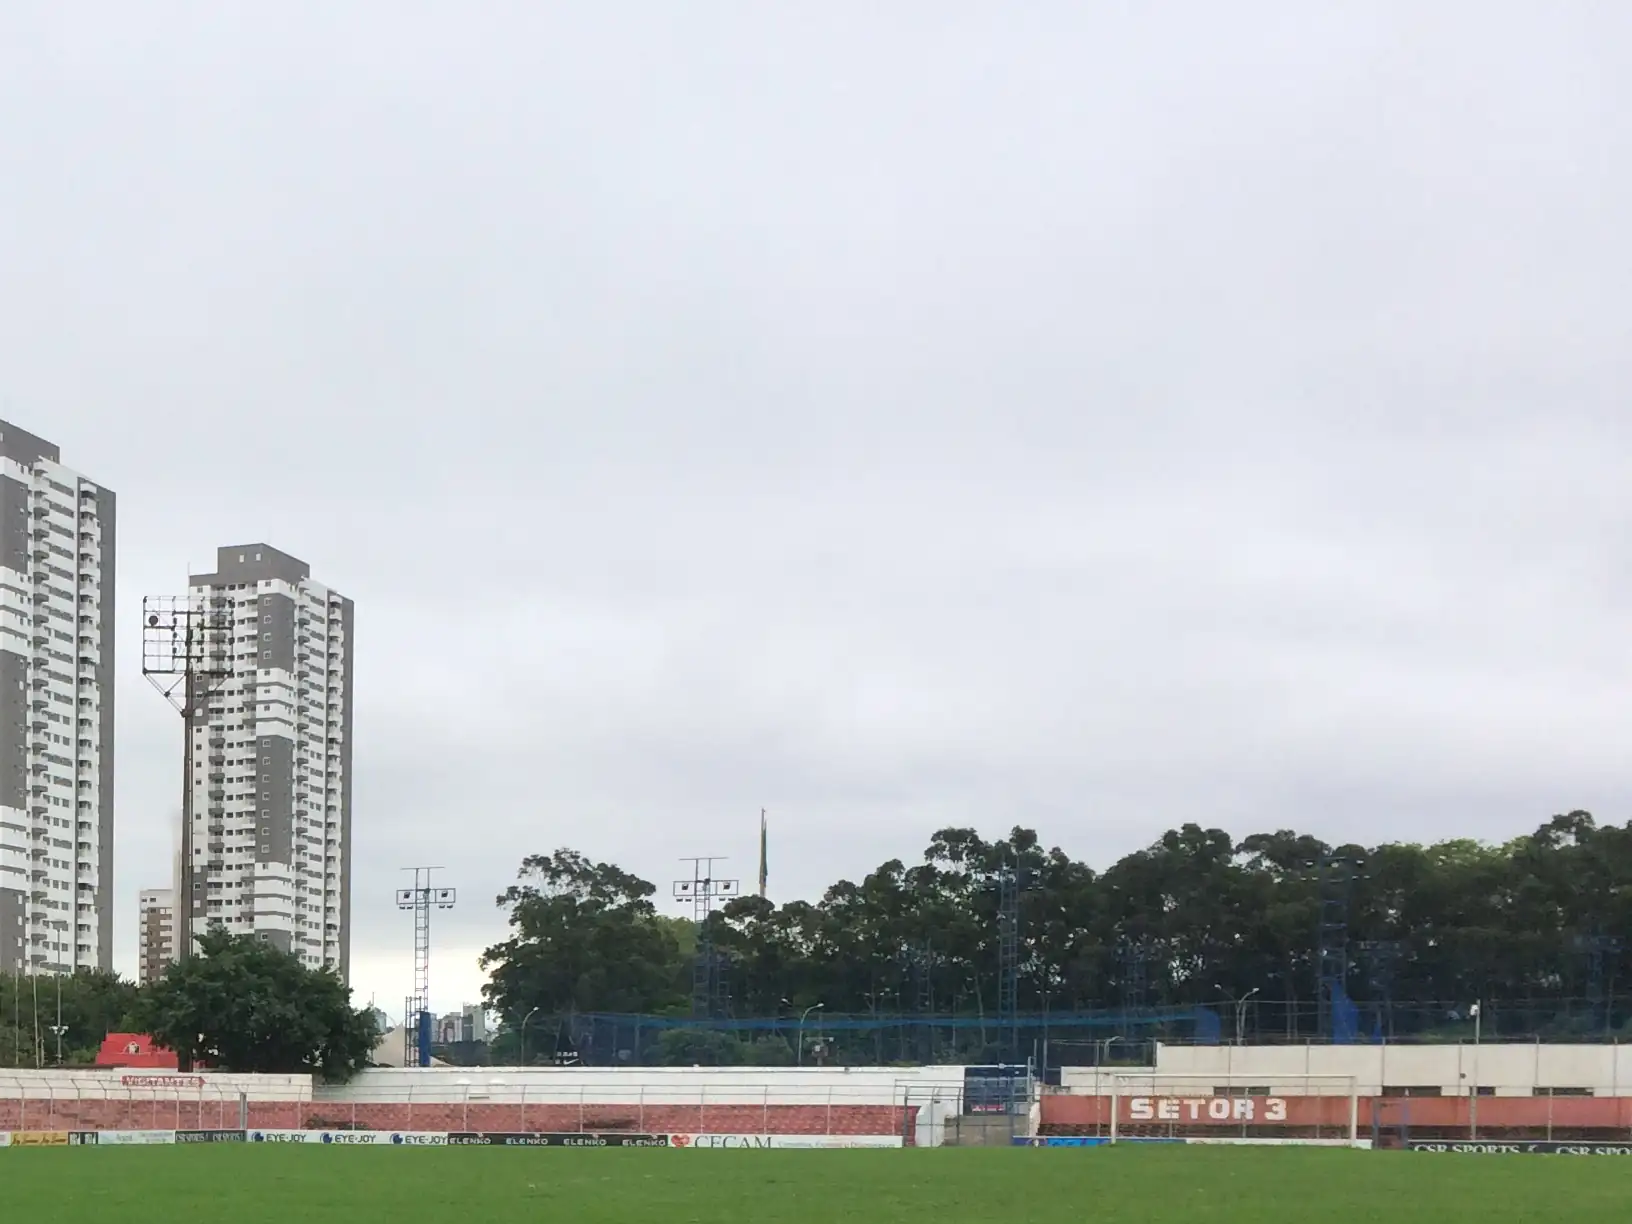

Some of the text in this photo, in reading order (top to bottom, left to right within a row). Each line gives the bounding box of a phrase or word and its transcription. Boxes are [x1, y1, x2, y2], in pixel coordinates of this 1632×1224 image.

[1130, 1098, 1287, 1120] SETOR 3
[506, 1137, 548, 1145] ELENKO
[563, 1138, 607, 1146] ELENKO
[622, 1139, 666, 1147] ELENKO
